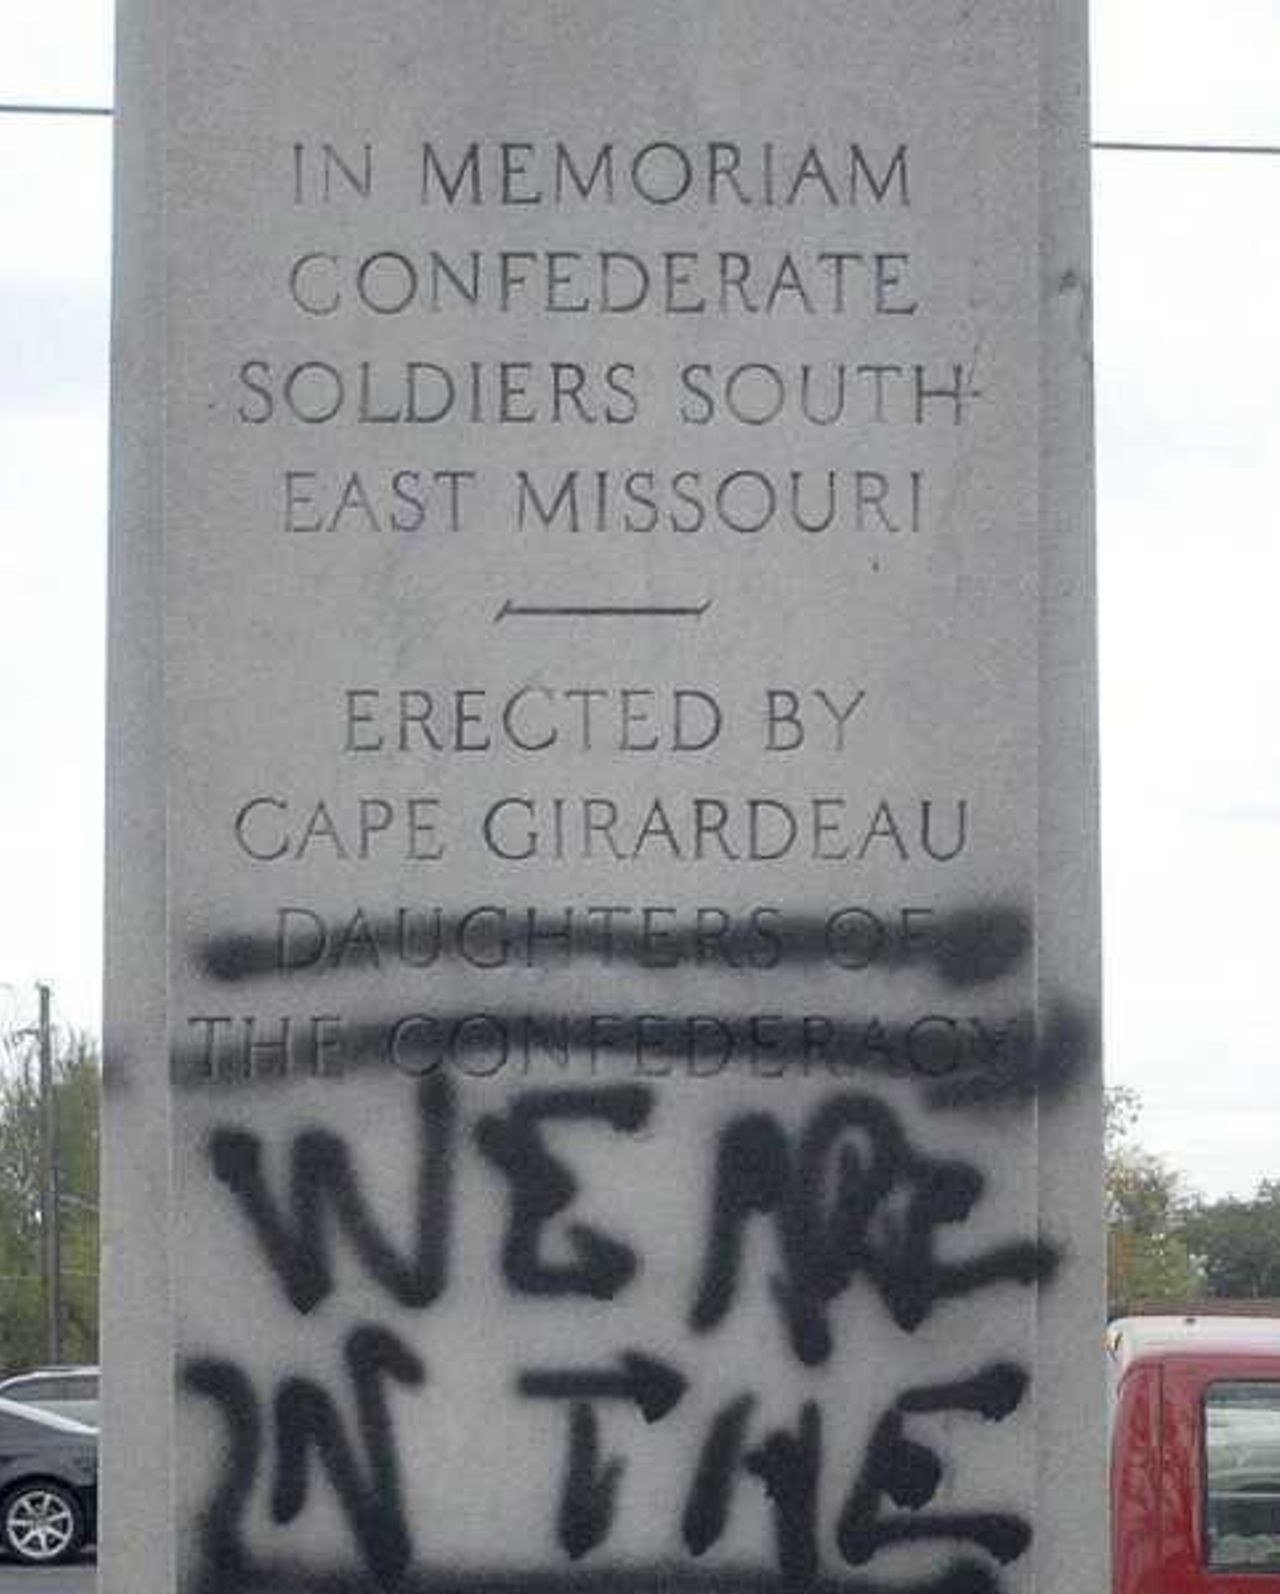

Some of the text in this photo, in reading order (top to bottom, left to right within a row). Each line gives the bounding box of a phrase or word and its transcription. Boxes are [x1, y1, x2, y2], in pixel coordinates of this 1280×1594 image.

[291, 140, 913, 206] IN MEMORIAM
[288, 250, 920, 316] CONFEDERATE
[237, 360, 974, 427] SOLDIERS SOUTH
[283, 469, 924, 535] EAST MISSOURI
[342, 686, 868, 752] ERECTED BY
[234, 798, 971, 862] CAPE GIRARDEAU
[273, 905, 936, 970] DAUGHTERS OF
[187, 1014, 1026, 1081] THE CONFEDERACY
[208, 1068, 654, 1315] WE
[517, 1352, 1032, 1580] THE
